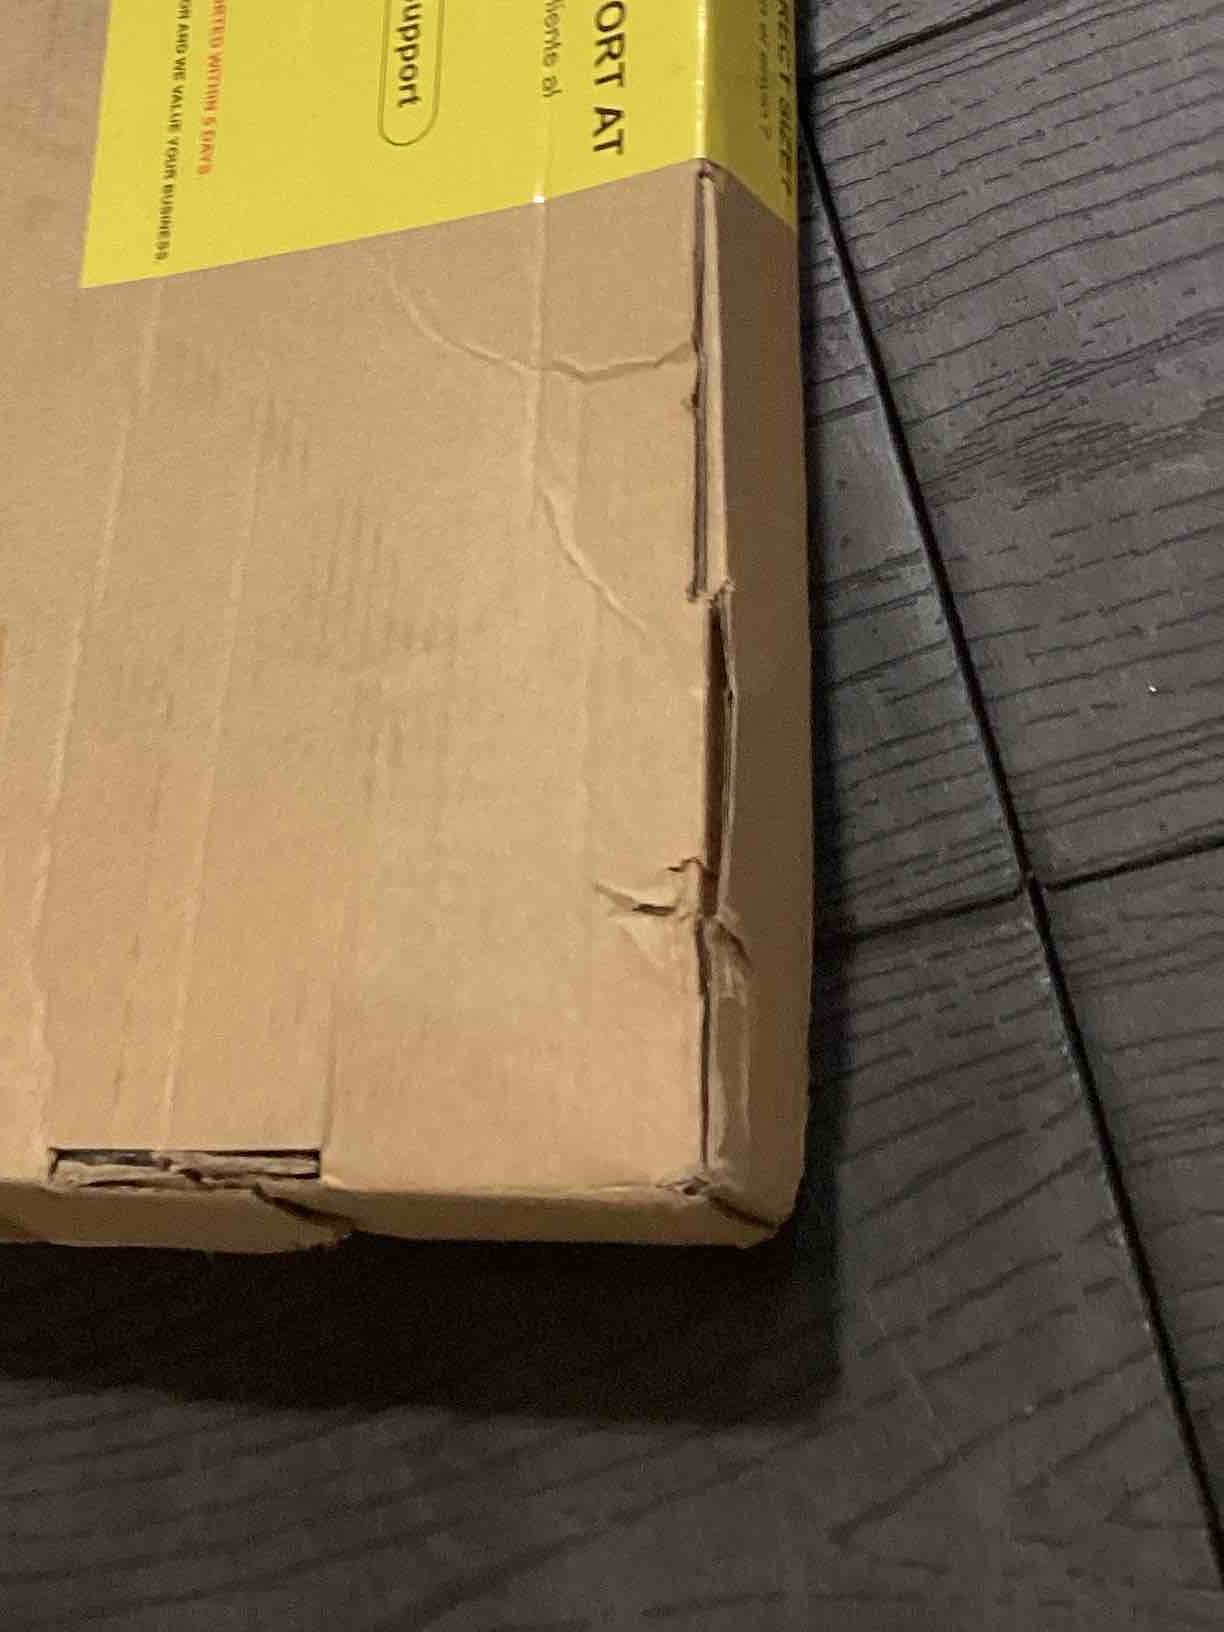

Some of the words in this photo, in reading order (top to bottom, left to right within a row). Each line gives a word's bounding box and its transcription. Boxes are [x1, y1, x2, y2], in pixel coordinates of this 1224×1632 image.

[175, 23, 190, 54] AND
[172, 56, 187, 80] WE
[203, 53, 223, 111] WITHIN
[167, 85, 184, 132] VALUE
[591, 105, 625, 156] AT
[163, 135, 180, 179] YOUR
